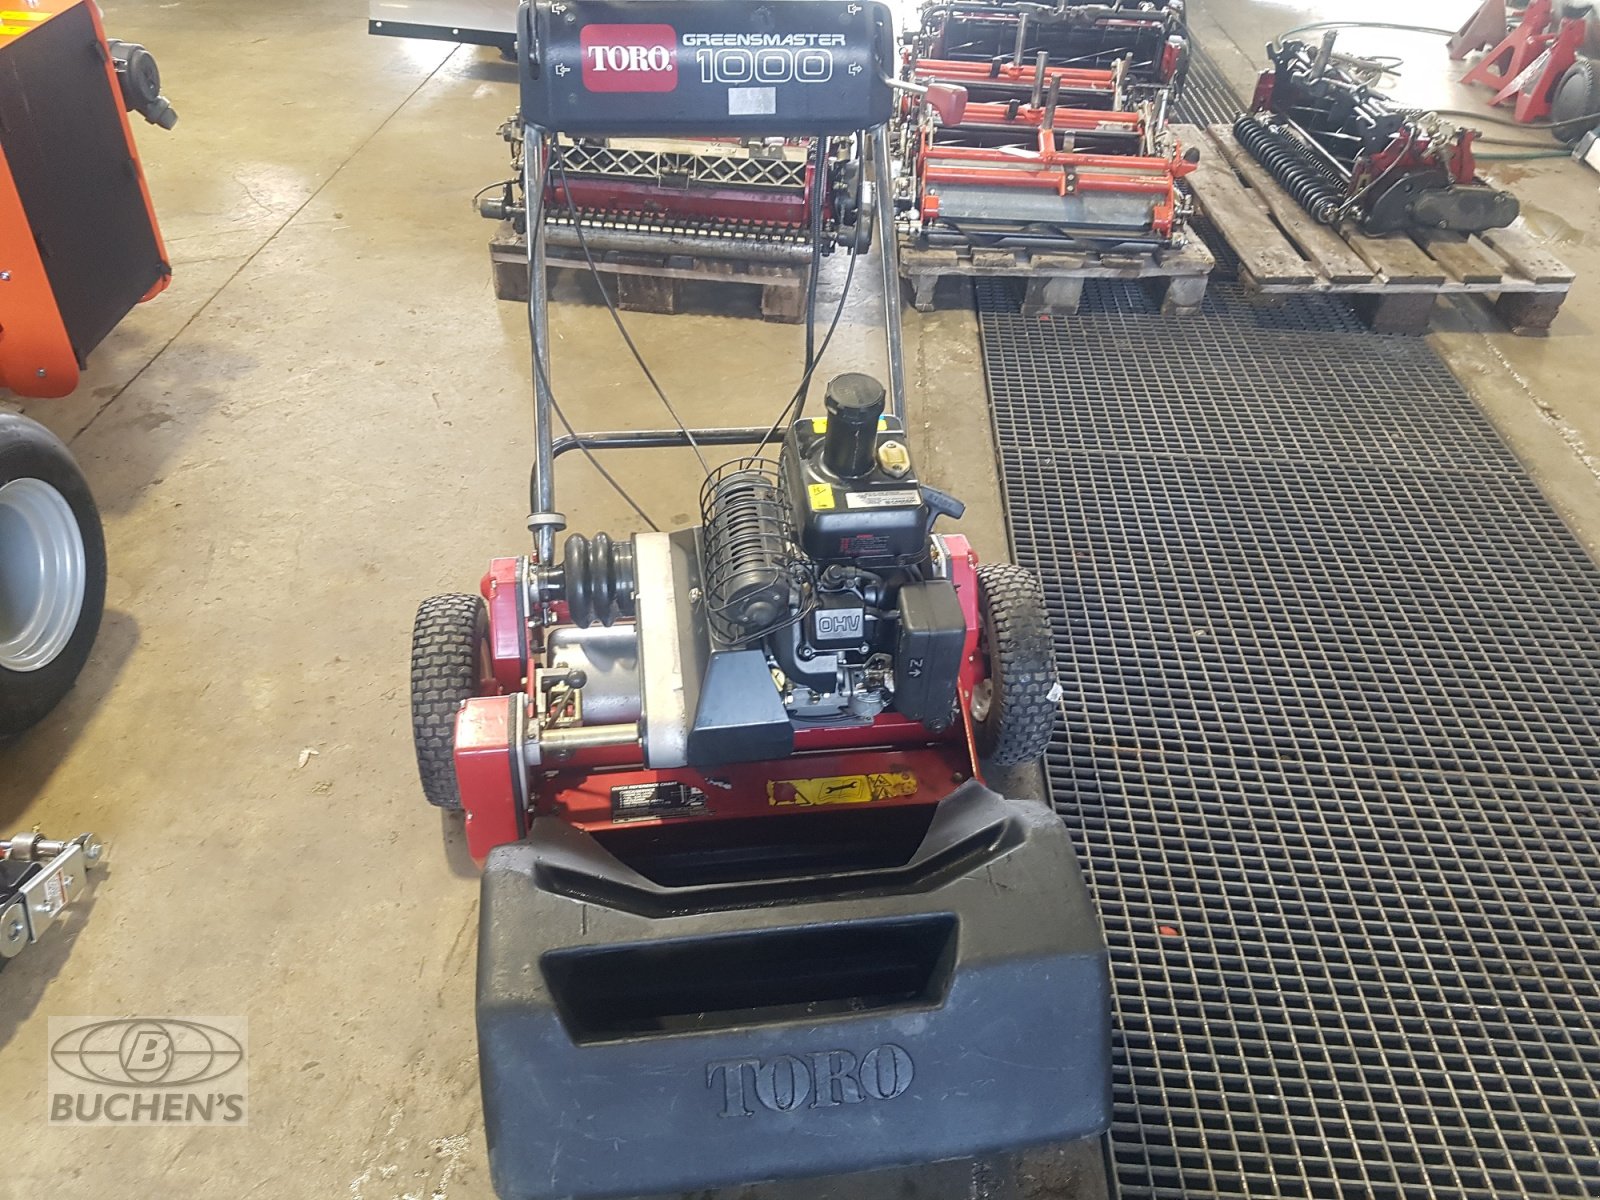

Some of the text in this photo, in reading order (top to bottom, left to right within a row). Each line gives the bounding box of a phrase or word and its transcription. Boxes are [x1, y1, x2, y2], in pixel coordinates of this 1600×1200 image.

[682, 33, 846, 47] GREENSMASTER
[696, 48, 834, 83] 1000
[818, 614, 861, 633] OHV
[706, 1043, 915, 1118] TORO
